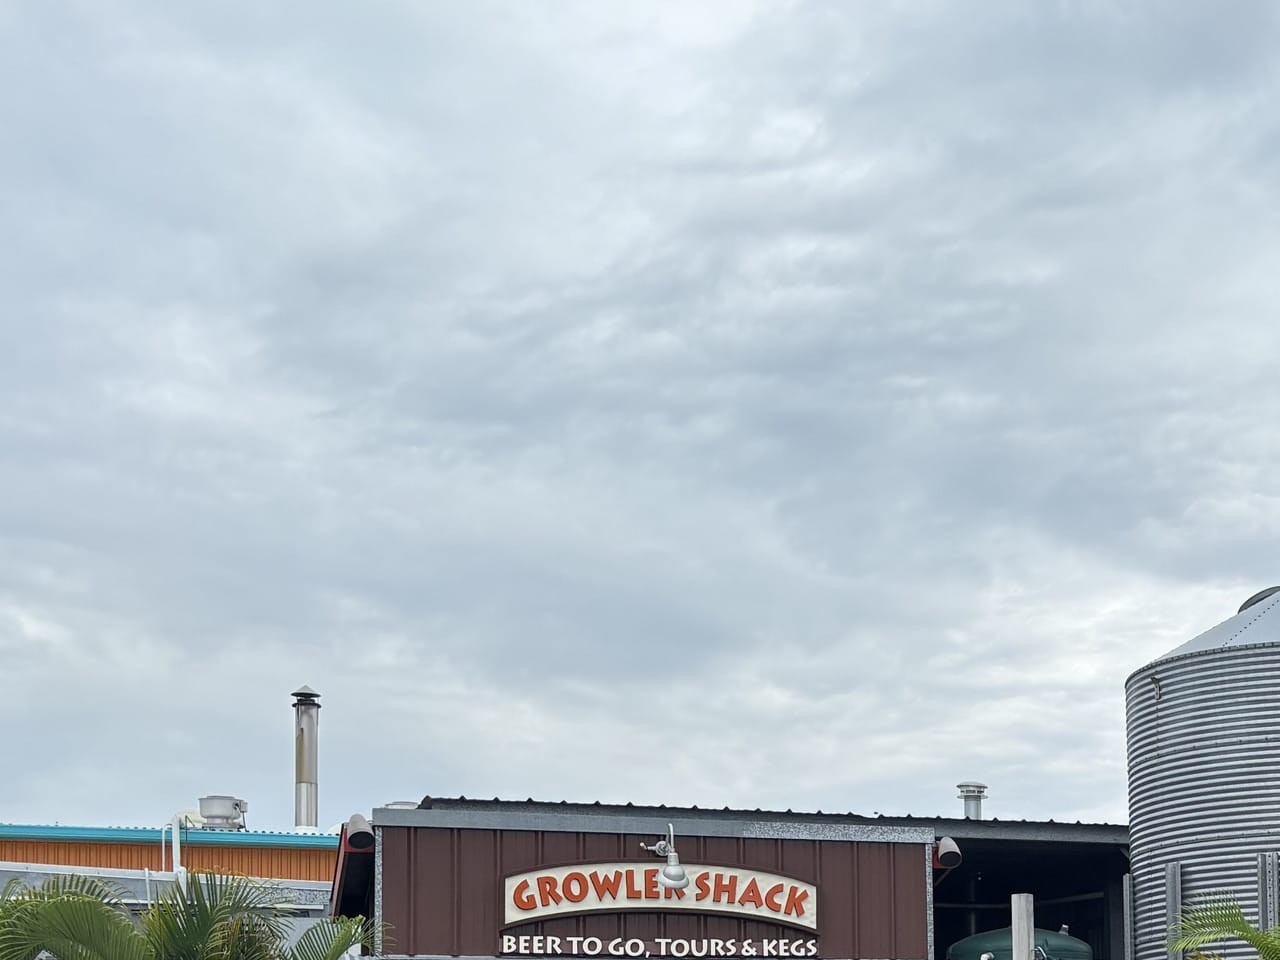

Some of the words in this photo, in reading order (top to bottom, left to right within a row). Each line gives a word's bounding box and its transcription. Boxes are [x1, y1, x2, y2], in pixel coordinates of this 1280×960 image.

[694, 872, 811, 918] SHACK
[502, 935, 562, 955] BEER
[566, 936, 603, 956] TO
[607, 936, 650, 959] GO,
[655, 938, 737, 957] TOURS
[741, 939, 758, 957] &
[762, 938, 818, 958] KEGS
